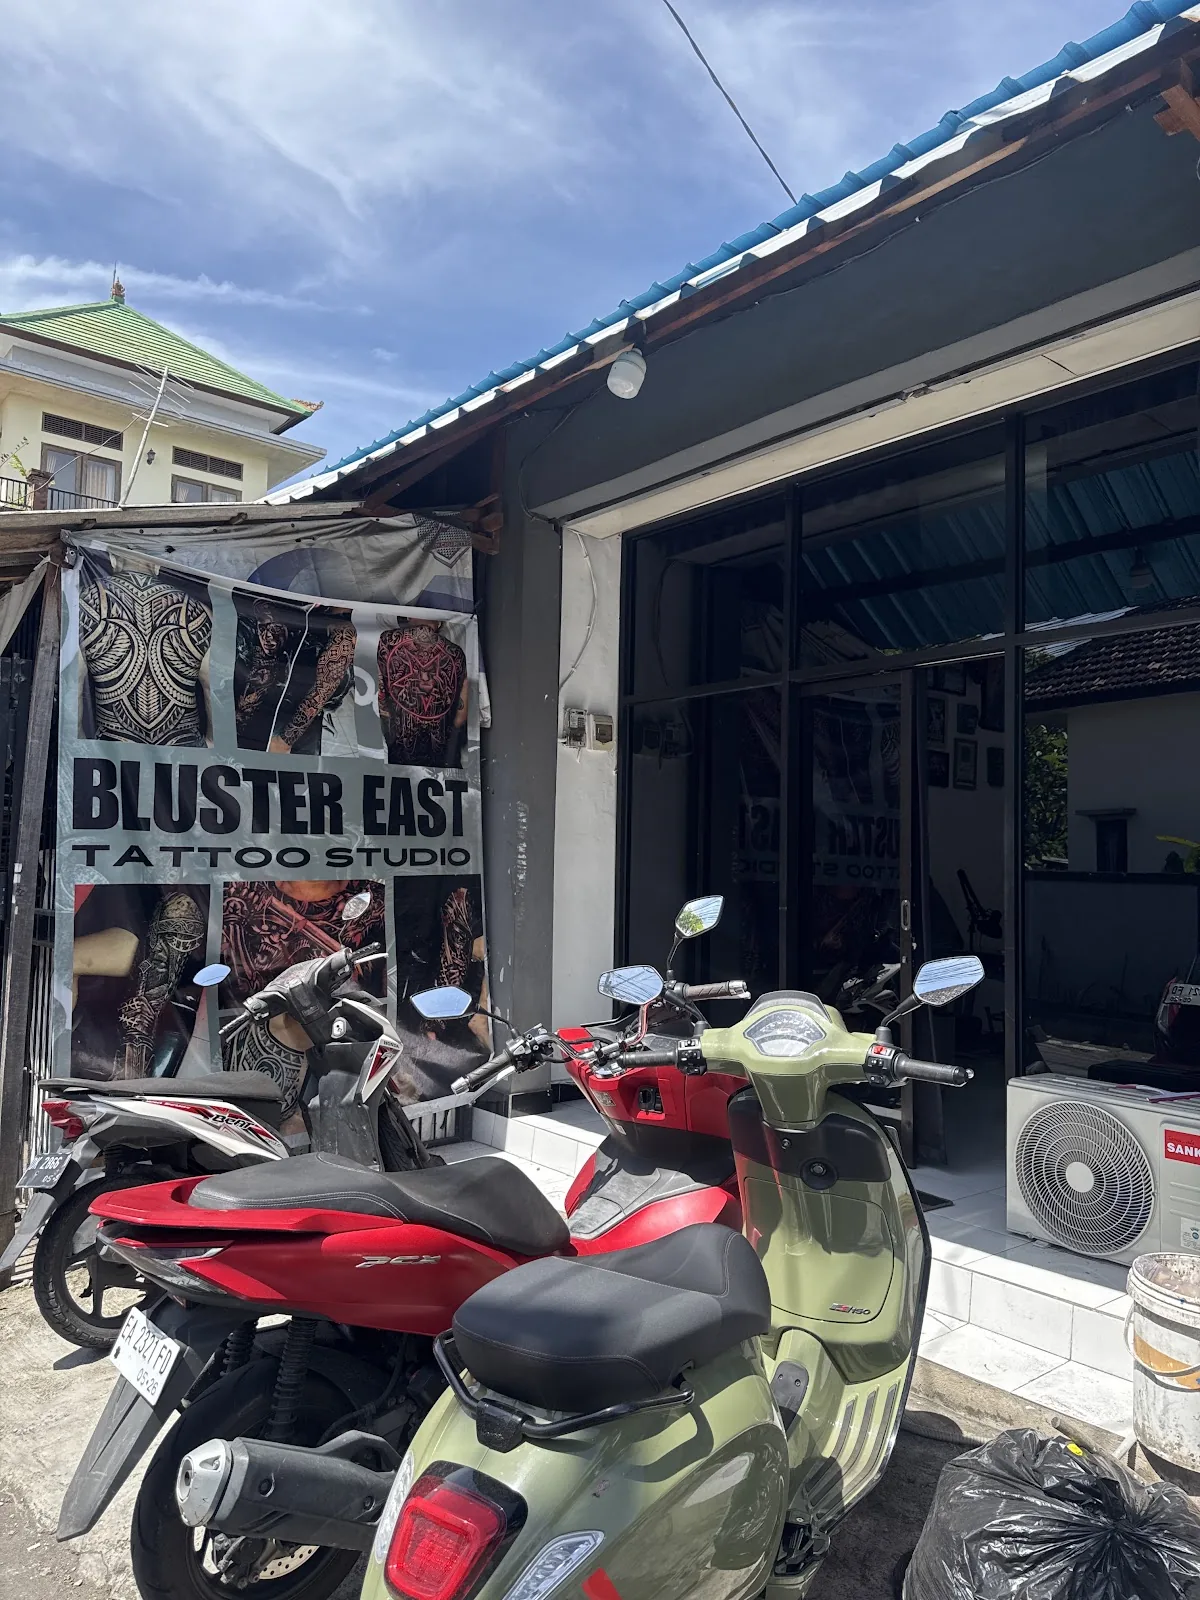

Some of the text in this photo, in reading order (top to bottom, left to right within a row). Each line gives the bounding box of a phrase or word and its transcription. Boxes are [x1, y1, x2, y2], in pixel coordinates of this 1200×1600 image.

[73, 757, 469, 837] BLUSTER EAST
[72, 845, 471, 868] TATTOO STUDIO
[383, 1040, 400, 1049] HONDA
[355, 1255, 442, 1268] PCX
[121, 1315, 172, 1375] EA 2321 FD
